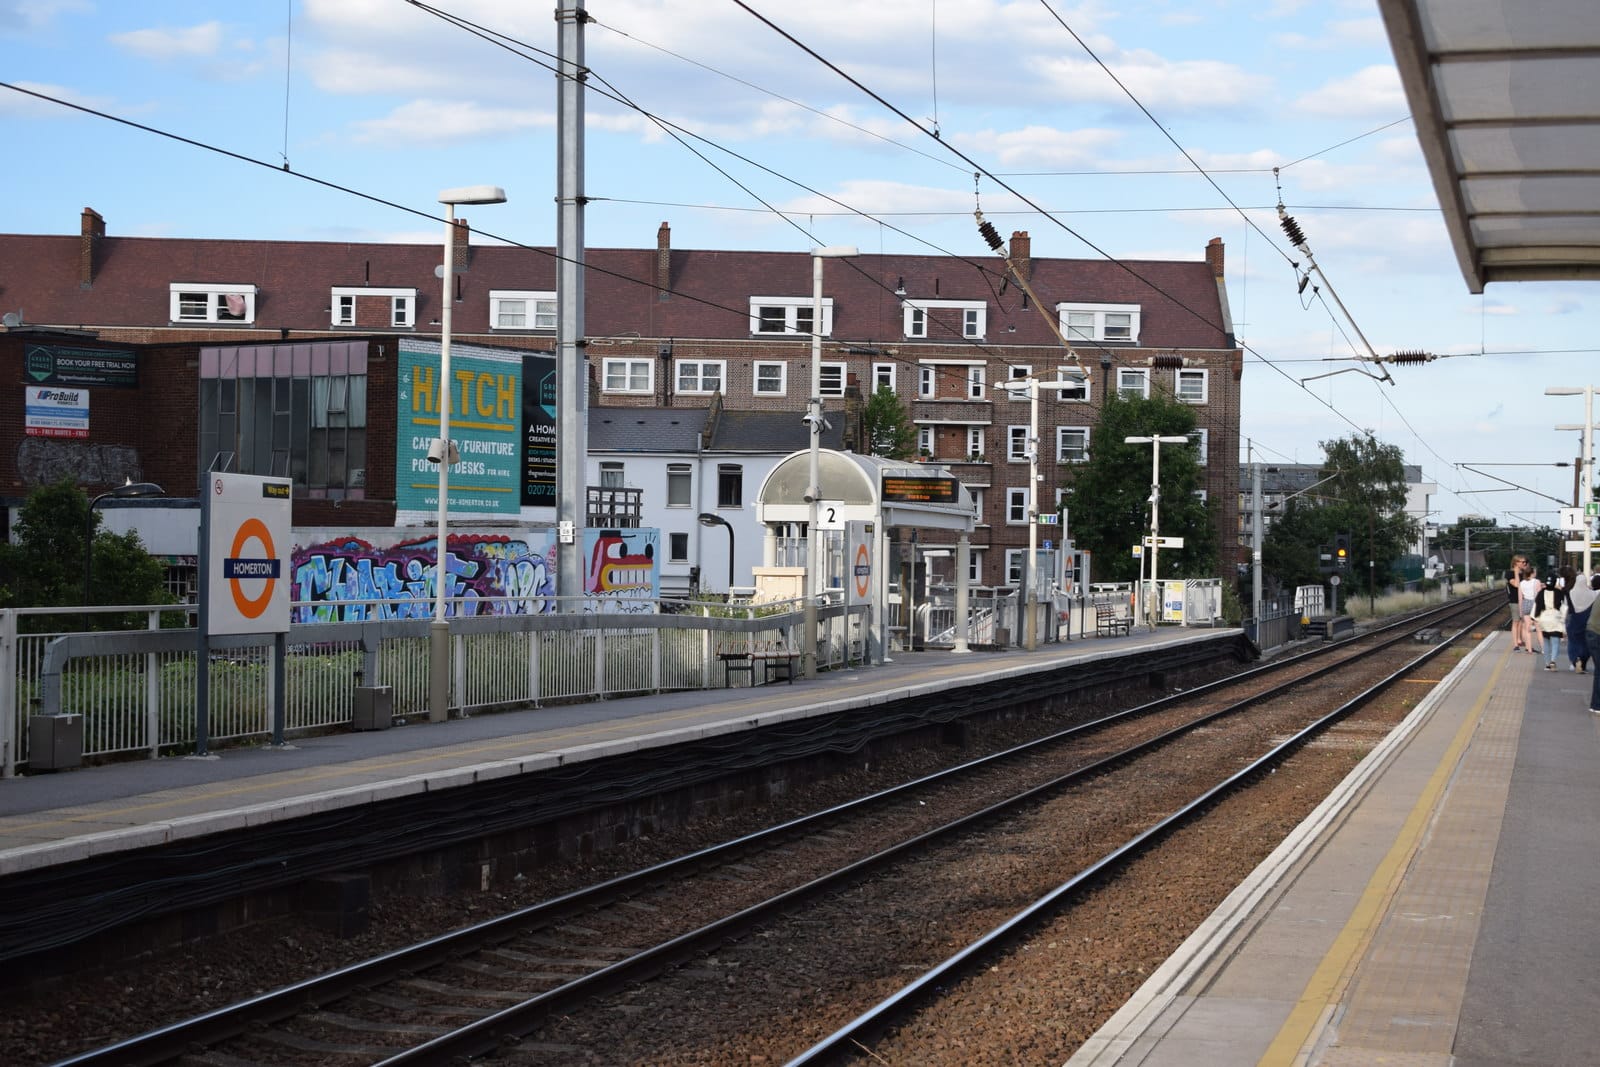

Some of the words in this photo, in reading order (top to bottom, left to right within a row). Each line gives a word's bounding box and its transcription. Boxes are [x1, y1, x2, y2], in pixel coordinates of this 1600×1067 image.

[57, 358, 74, 366] BOOK
[106, 361, 121, 369] TRIAL
[536, 424, 556, 434] HOM
[826, 507, 836, 523] 2
[233, 562, 272, 575] HOMERTON
